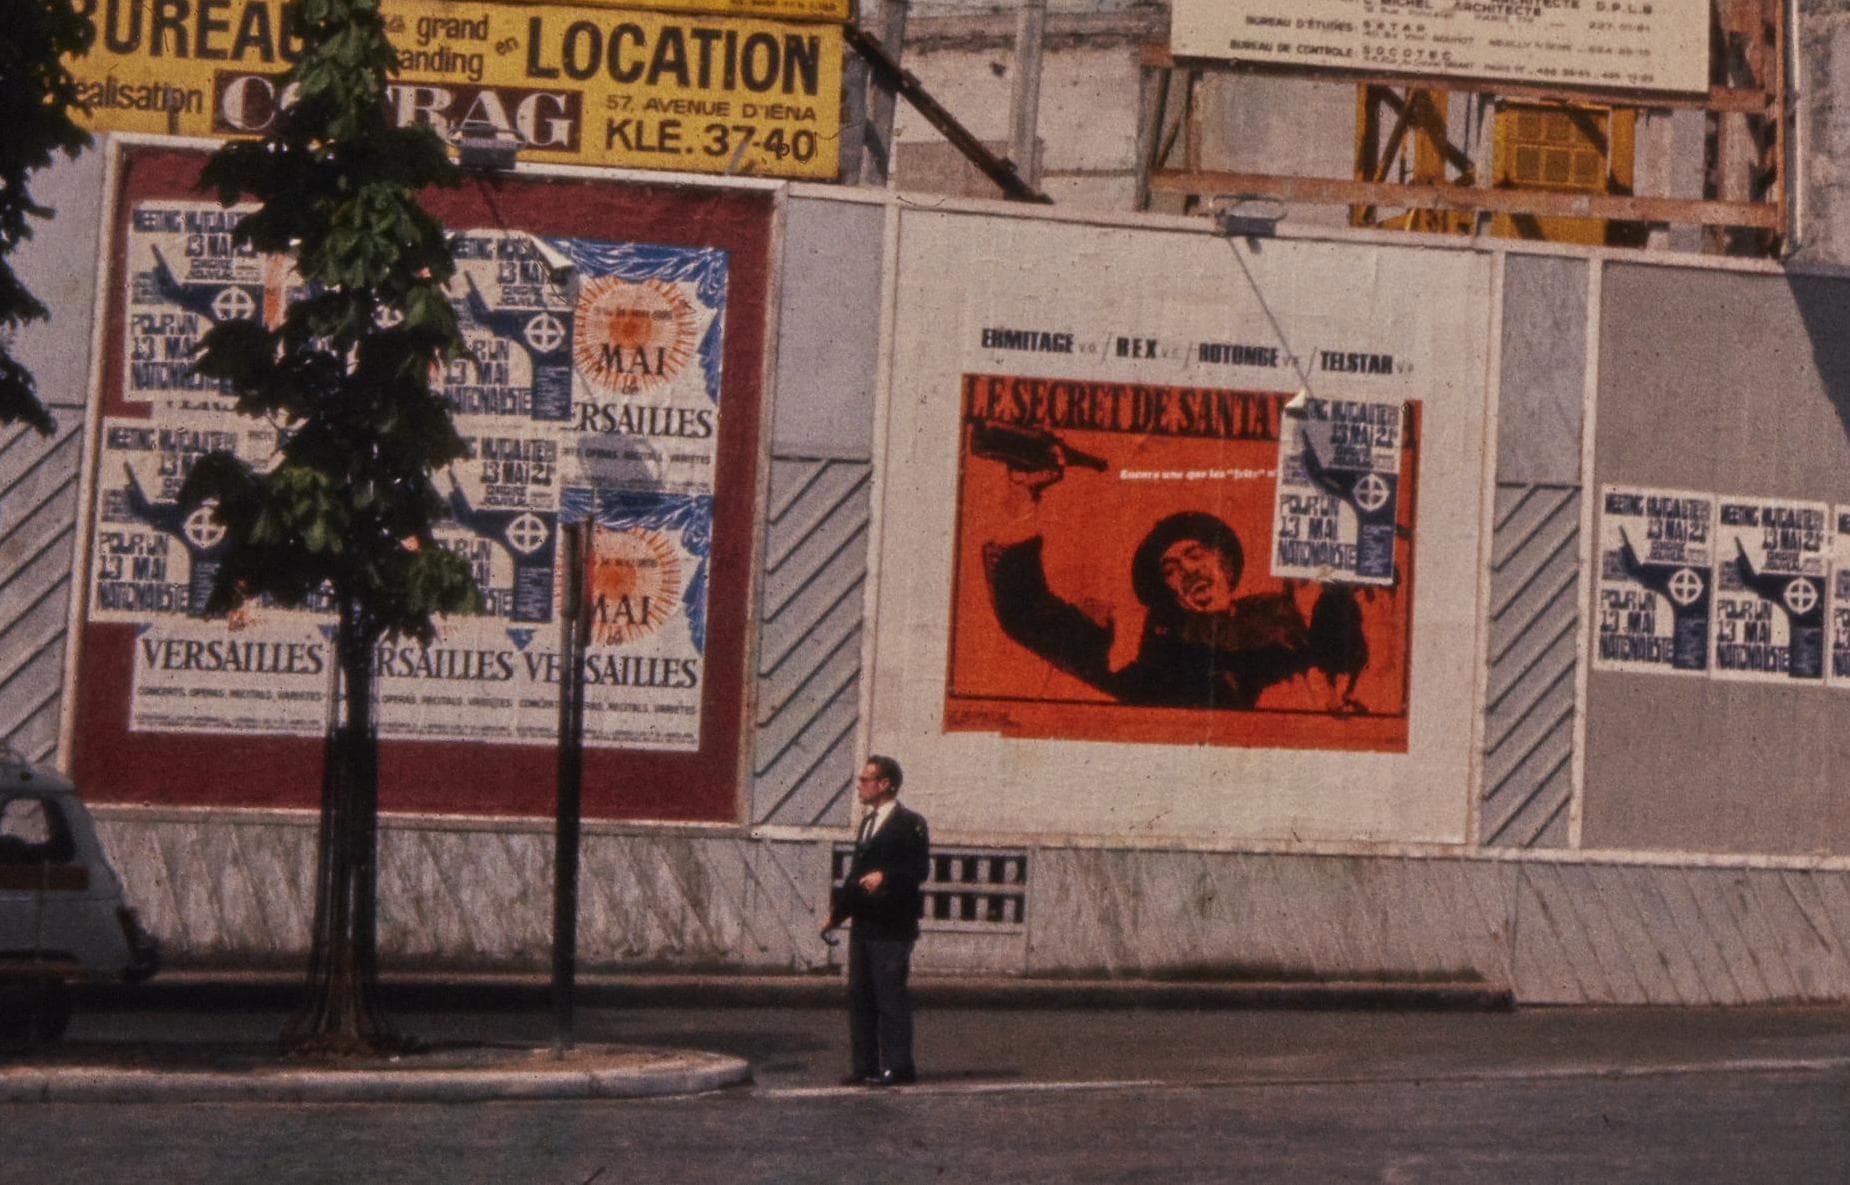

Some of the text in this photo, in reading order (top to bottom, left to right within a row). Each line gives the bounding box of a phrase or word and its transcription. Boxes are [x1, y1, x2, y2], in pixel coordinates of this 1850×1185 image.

[417, 14, 490, 47] grand
[397, 43, 485, 83] anding
[495, 16, 820, 97] en LOCATION
[75, 77, 204, 115] ealisation
[643, 97, 731, 117] AVENUE
[605, 118, 818, 166] KLE. 37-40
[600, 343, 666, 376] MAI
[982, 328, 1074, 354] ERMITAGE
[1116, 336, 1158, 359] REX
[1320, 350, 1394, 374] TELSTAR
[570, 402, 713, 439] RSAILLES
[964, 374, 1274, 441] LE SECRET DE SANTA
[143, 638, 699, 689] VERSAILLES RSAILLES VESAILLES
